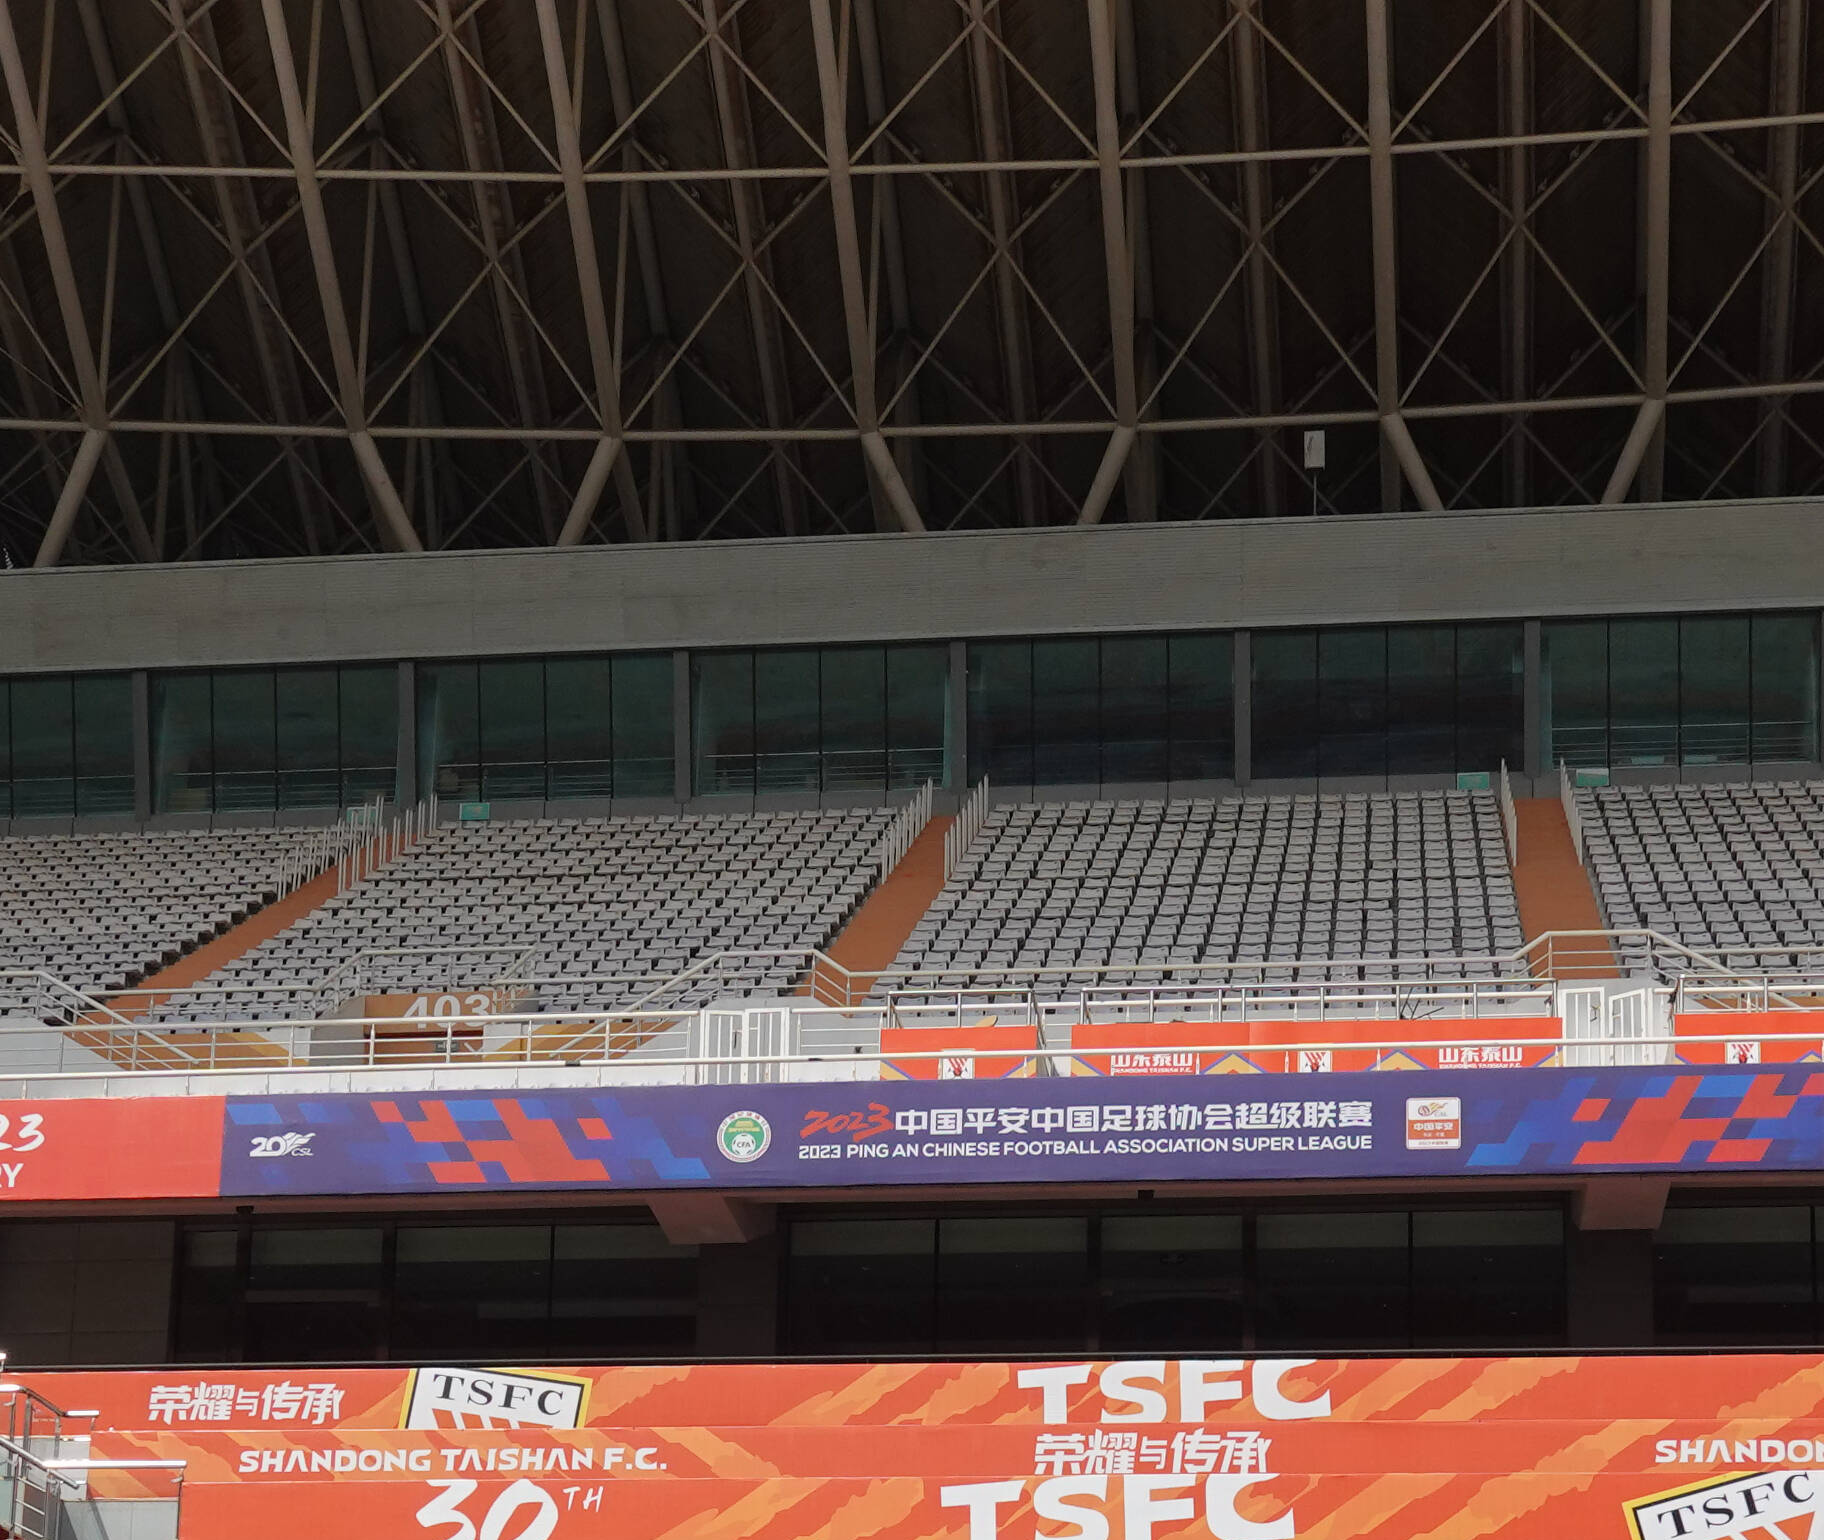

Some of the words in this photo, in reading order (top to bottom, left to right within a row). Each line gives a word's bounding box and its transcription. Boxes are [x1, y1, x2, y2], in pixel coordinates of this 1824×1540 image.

[403, 994, 491, 1029] 403
[895, 1100, 1373, 1136] 中国平安中国足球协会超级联赛
[798, 1144, 841, 1160] 2023
[846, 1144, 889, 1159] PING
[892, 1143, 919, 1158] AN
[922, 1141, 1001, 1158] CHINESE
[1003, 1139, 1101, 1156] FOOTBALL
[1103, 1137, 1228, 1155] ASSOCIATION
[1231, 1136, 1295, 1152] SUPER
[1297, 1135, 1372, 1151] LEAGUE
[148, 1381, 345, 1424] 荣耀与传承
[433, 1374, 564, 1416] TSFC
[1017, 1359, 1332, 1424] TSFC
[239, 1449, 432, 1473] SHANDONG
[440, 1447, 594, 1472] TAISHAN
[603, 1447, 667, 1470] F.C.
[1035, 1430, 1272, 1474] 荣耀与传承
[562, 1485, 604, 1514] TH
[1657, 1471, 1815, 1539] TSFC
